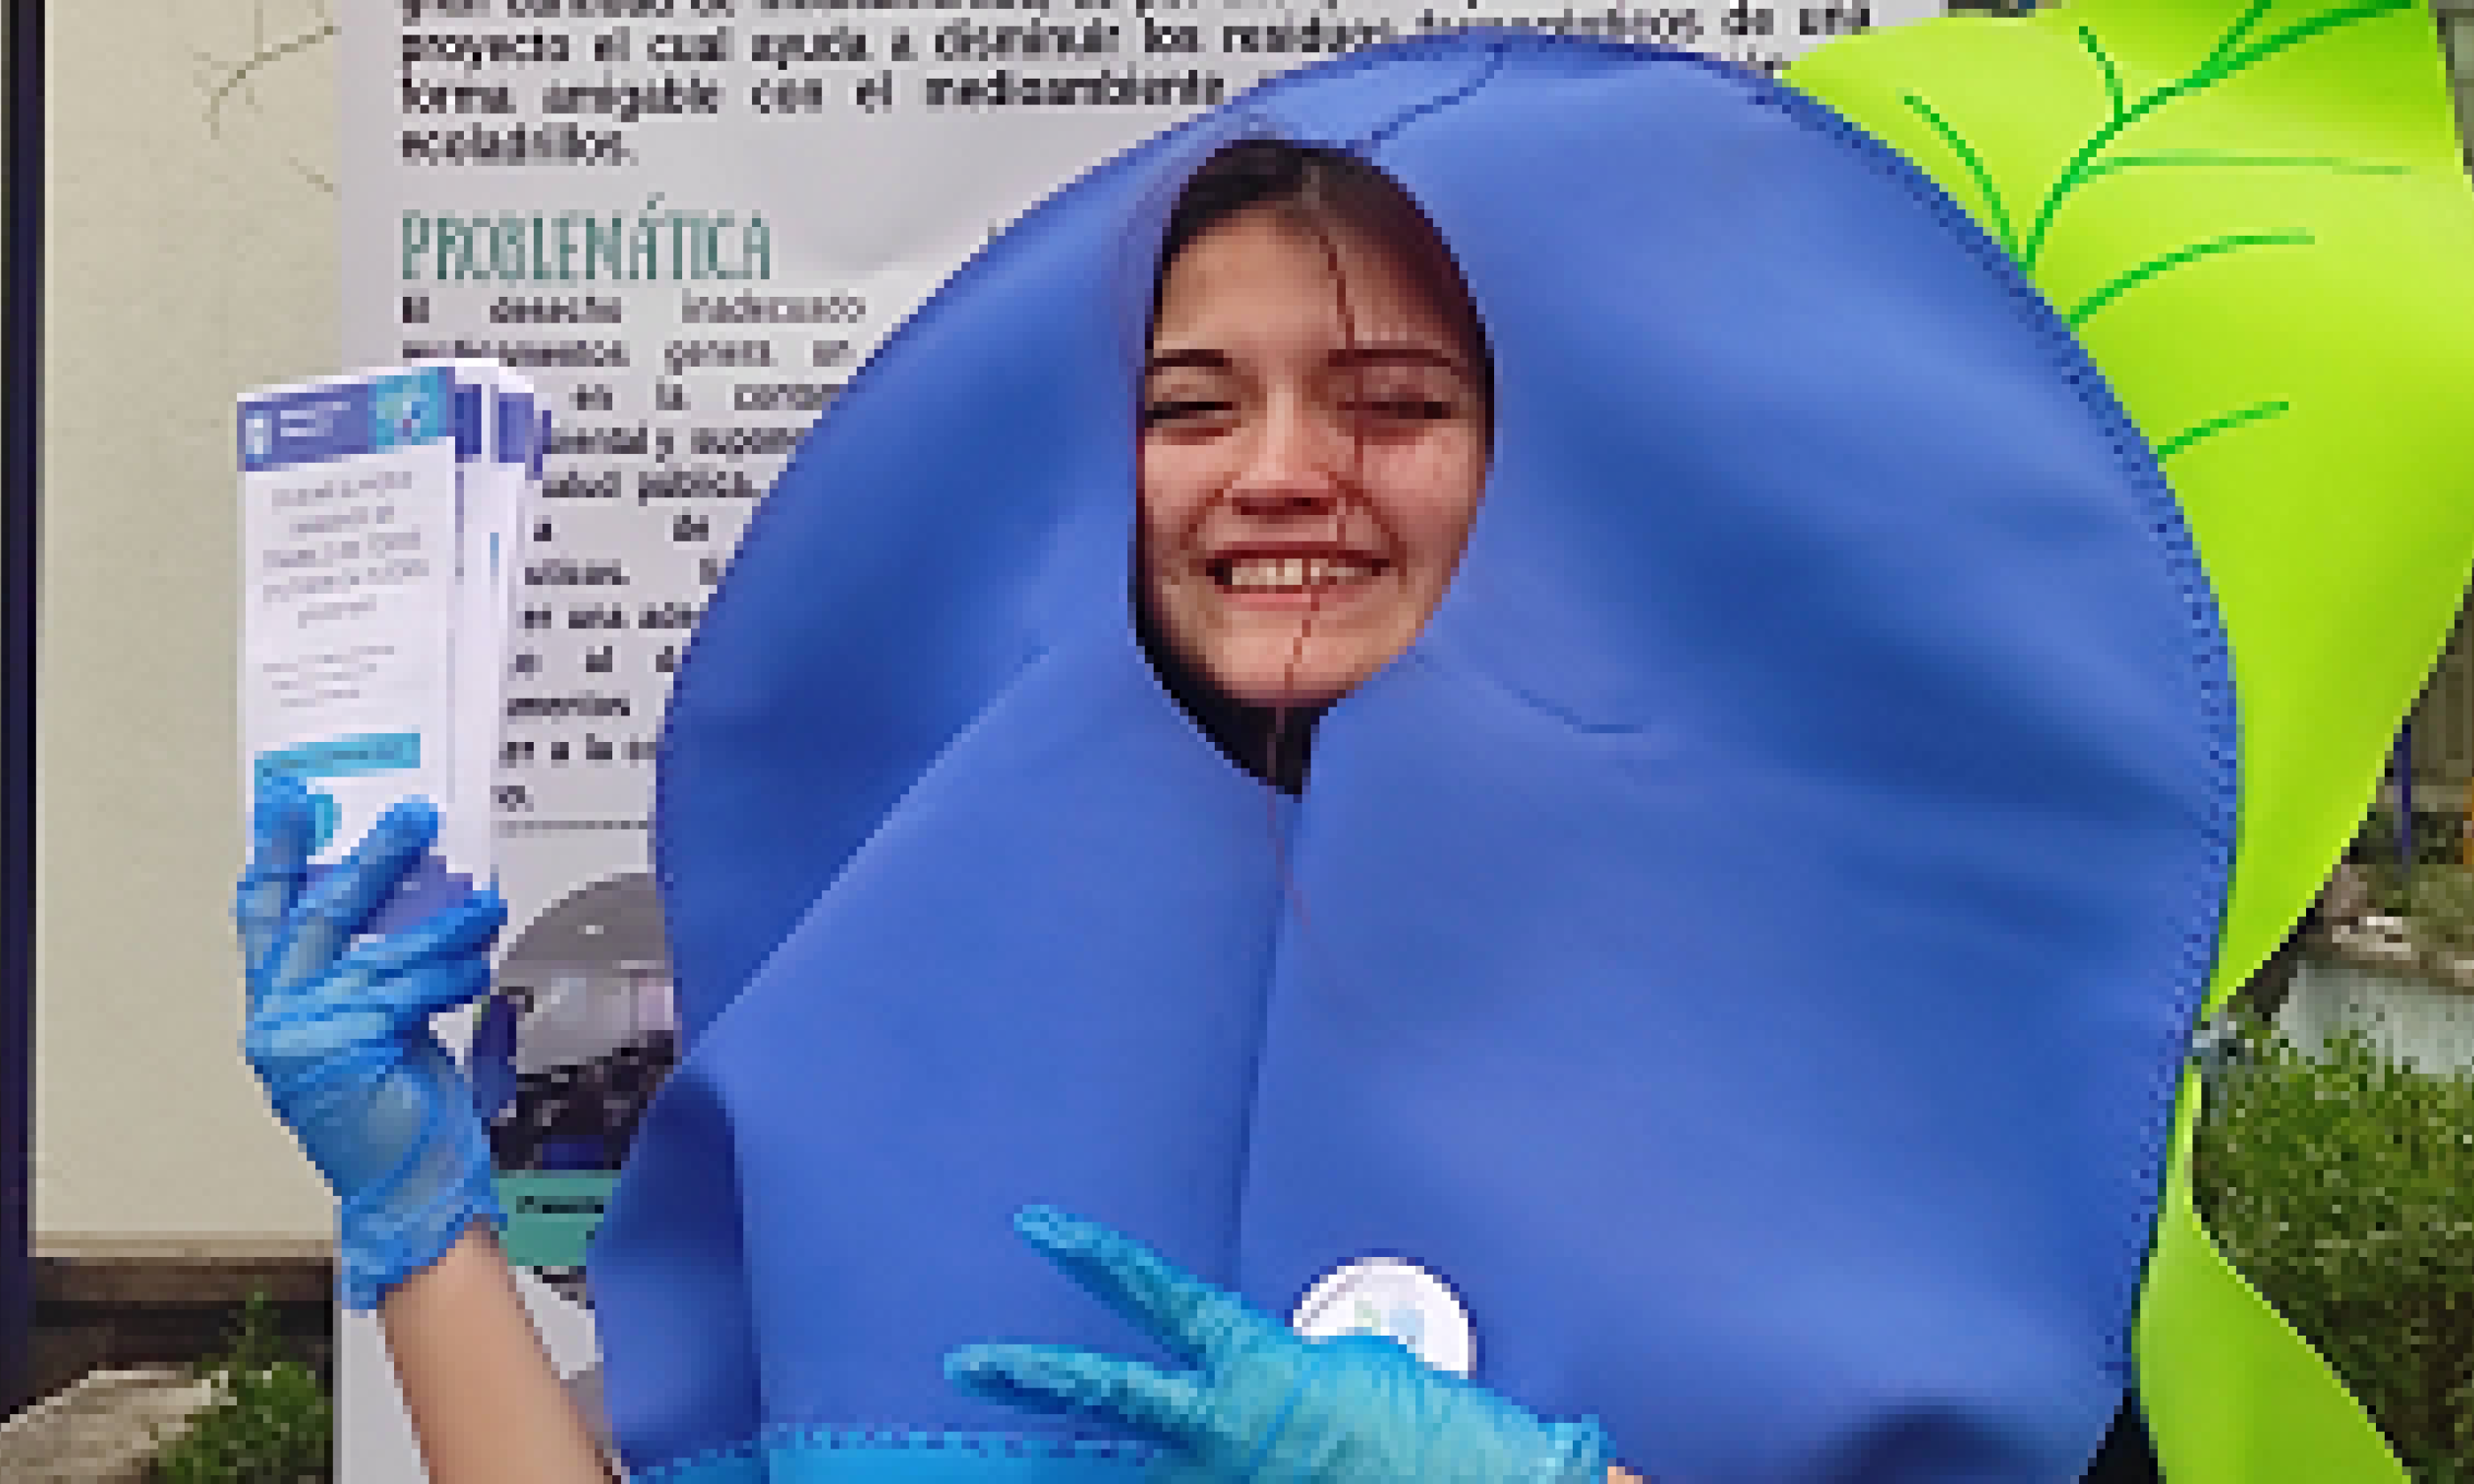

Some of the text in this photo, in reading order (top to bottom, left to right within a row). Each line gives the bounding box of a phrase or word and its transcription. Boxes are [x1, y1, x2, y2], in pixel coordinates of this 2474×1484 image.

[401, 30, 568, 72] proyecto
[648, 26, 728, 61] cual
[752, 25, 867, 68] ayuda
[1144, 16, 1197, 52] los
[543, 71, 720, 122] amigable
[751, 76, 823, 114] con
[924, 65, 1226, 108] medioambiente
[401, 189, 772, 281] PROBLEMÁTICA
[680, 288, 868, 324] inadecuado
